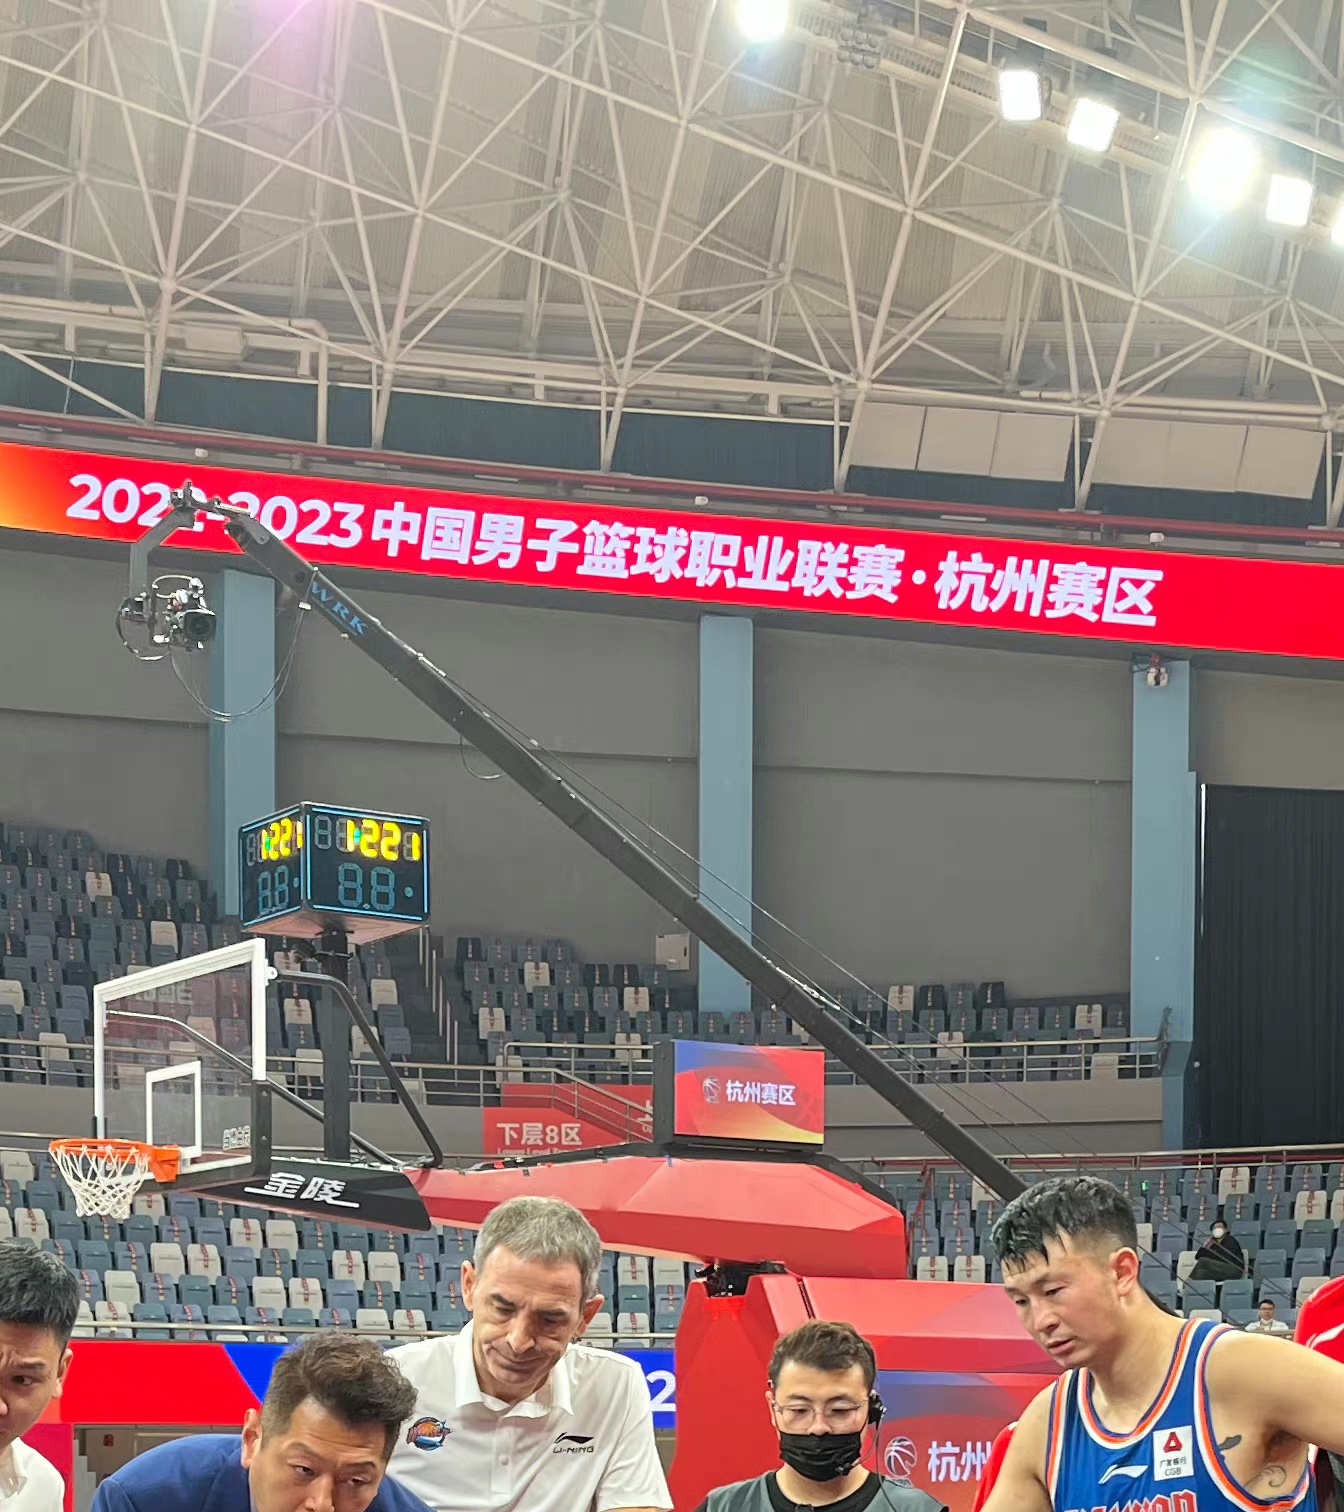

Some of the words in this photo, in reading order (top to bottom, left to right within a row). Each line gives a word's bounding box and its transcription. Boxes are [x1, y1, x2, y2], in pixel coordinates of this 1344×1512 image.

[65, 473, 1164, 627] 202-2023中国男子篮球职业联赛·杭州赛区
[725, 1079, 797, 1107] 杭州赛区
[496, 1122, 583, 1147] 下层8区
[244, 1171, 360, 1209] 金陵
